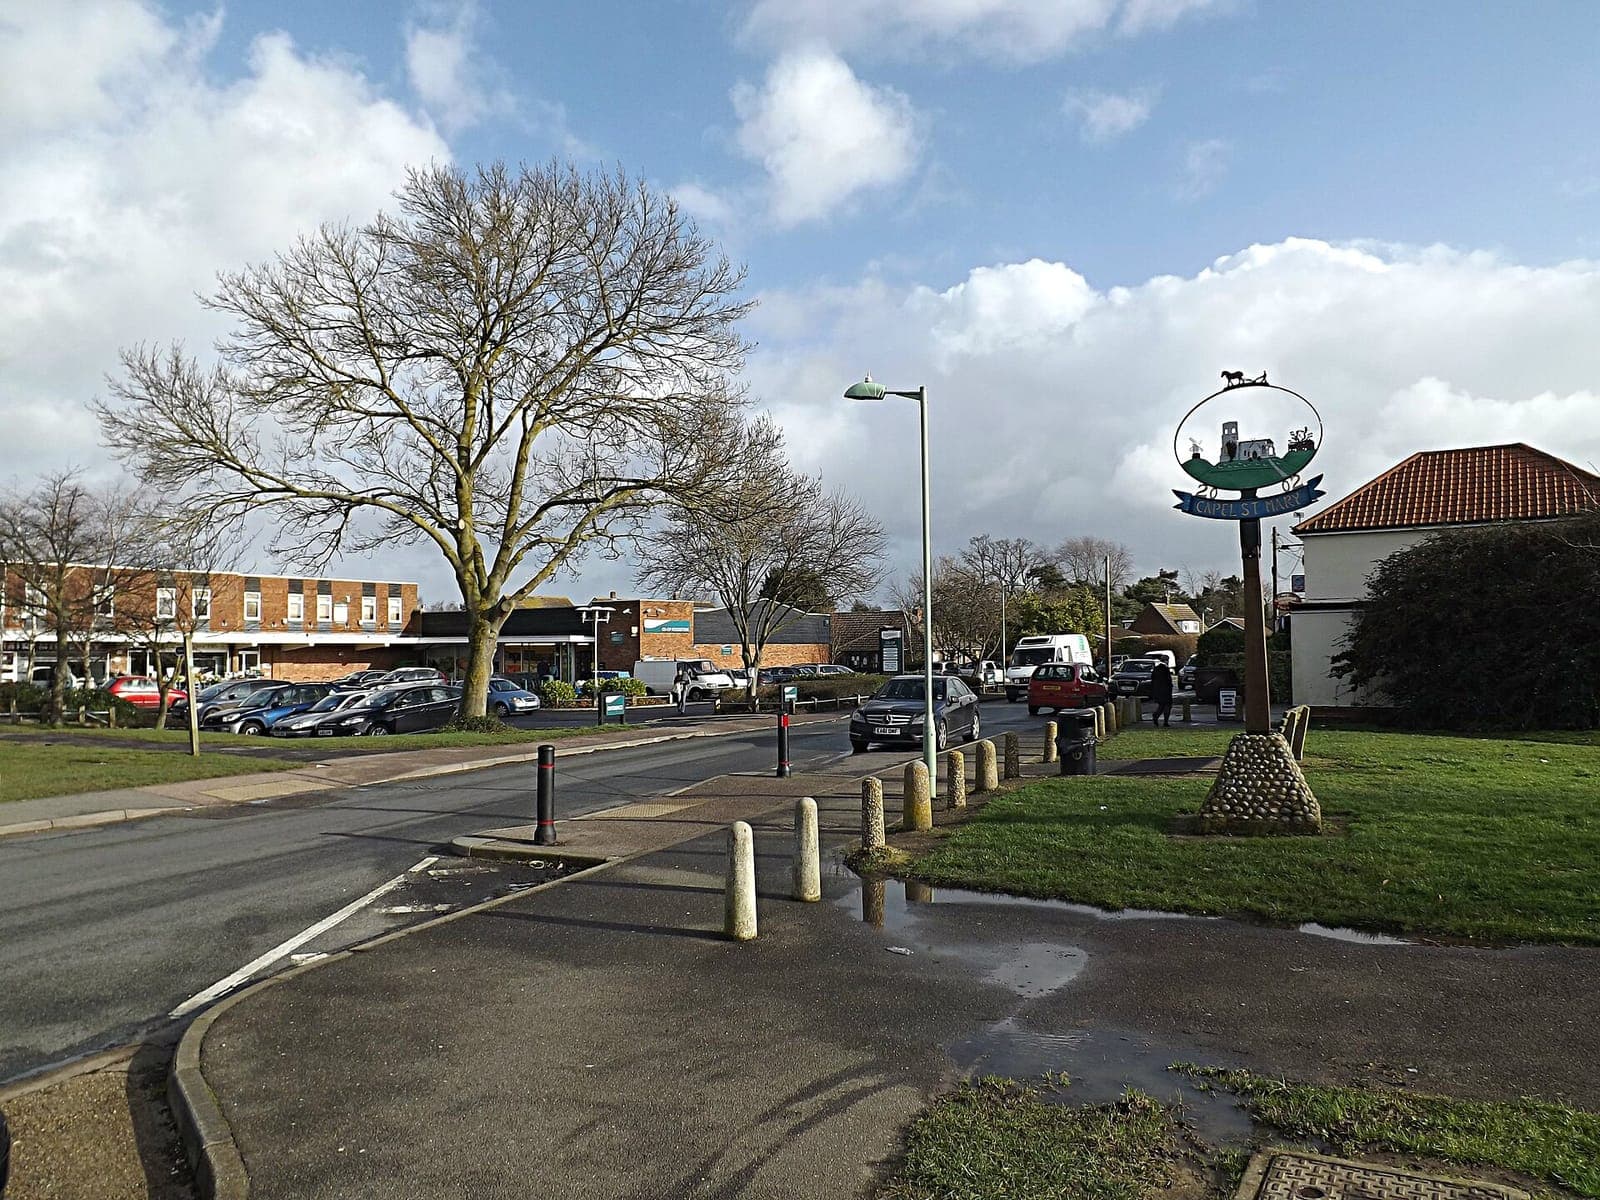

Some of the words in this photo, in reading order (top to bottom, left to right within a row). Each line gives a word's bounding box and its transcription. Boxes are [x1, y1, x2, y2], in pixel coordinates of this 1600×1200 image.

[1196, 484, 1217, 499] 20
[1281, 475, 1300, 492] 02
[1196, 501, 1237, 516] CAPEL
[1241, 501, 1260, 516] ST
[1265, 492, 1300, 513] MARY
